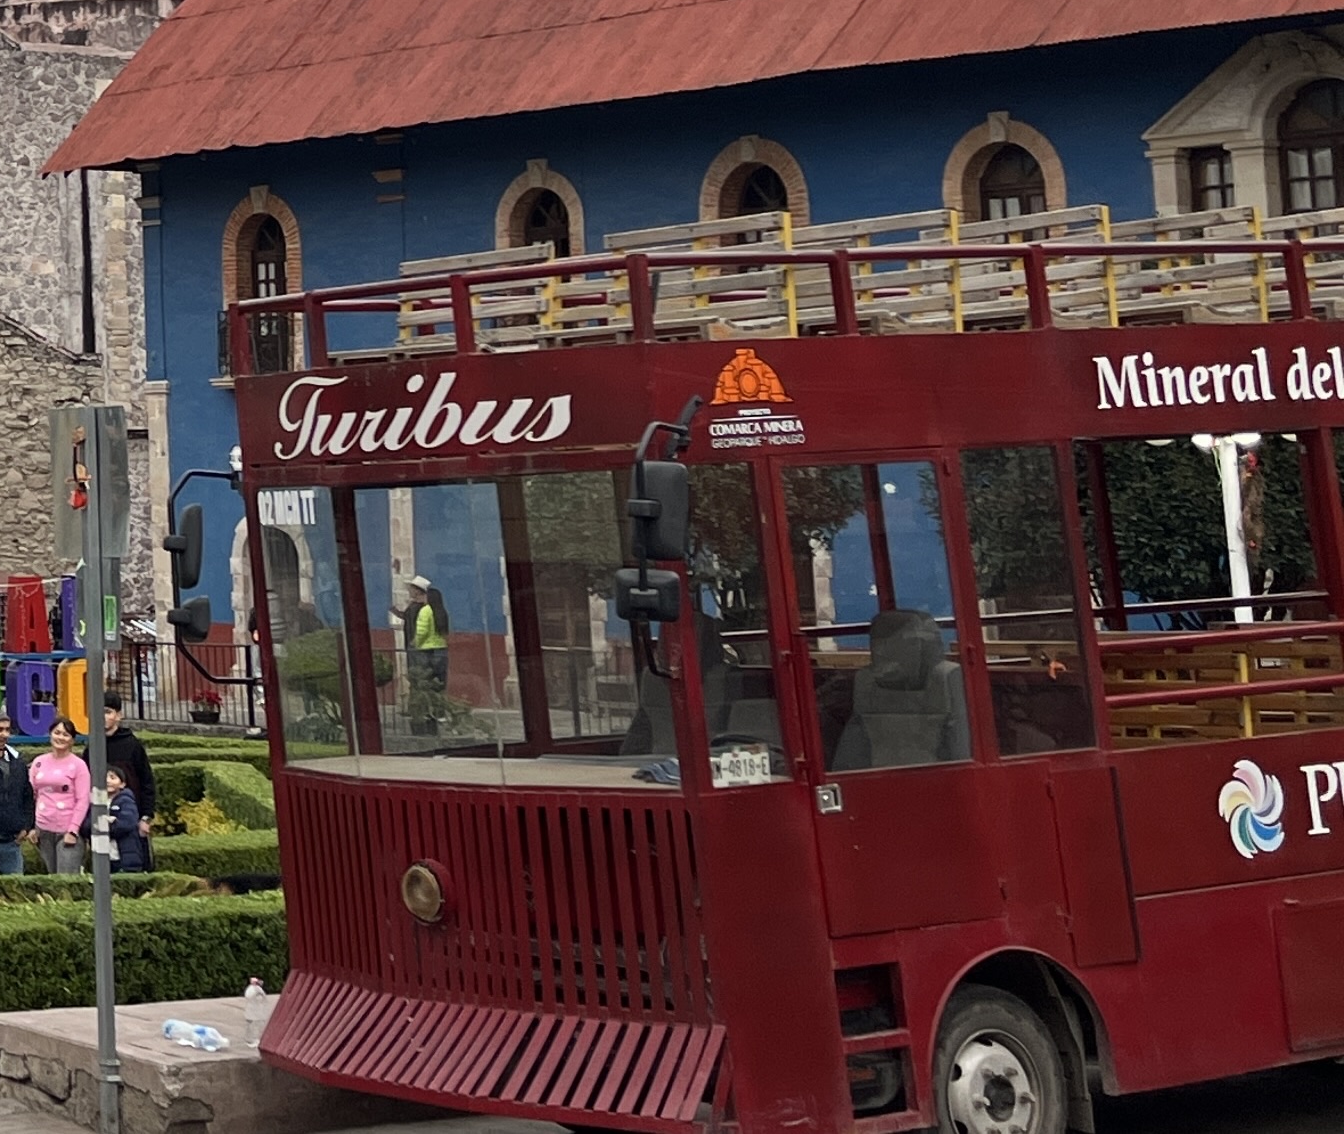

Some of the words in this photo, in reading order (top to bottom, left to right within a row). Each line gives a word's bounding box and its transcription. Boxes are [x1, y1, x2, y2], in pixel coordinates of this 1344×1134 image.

[1092, 346, 1277, 411] Mineral
[1286, 345, 1344, 401] del
[273, 371, 572, 460] Turibus
[709, 422, 763, 436] COMARCA
[763, 419, 804, 433] MINERA
[768, 434, 806, 446] HIDALGO
